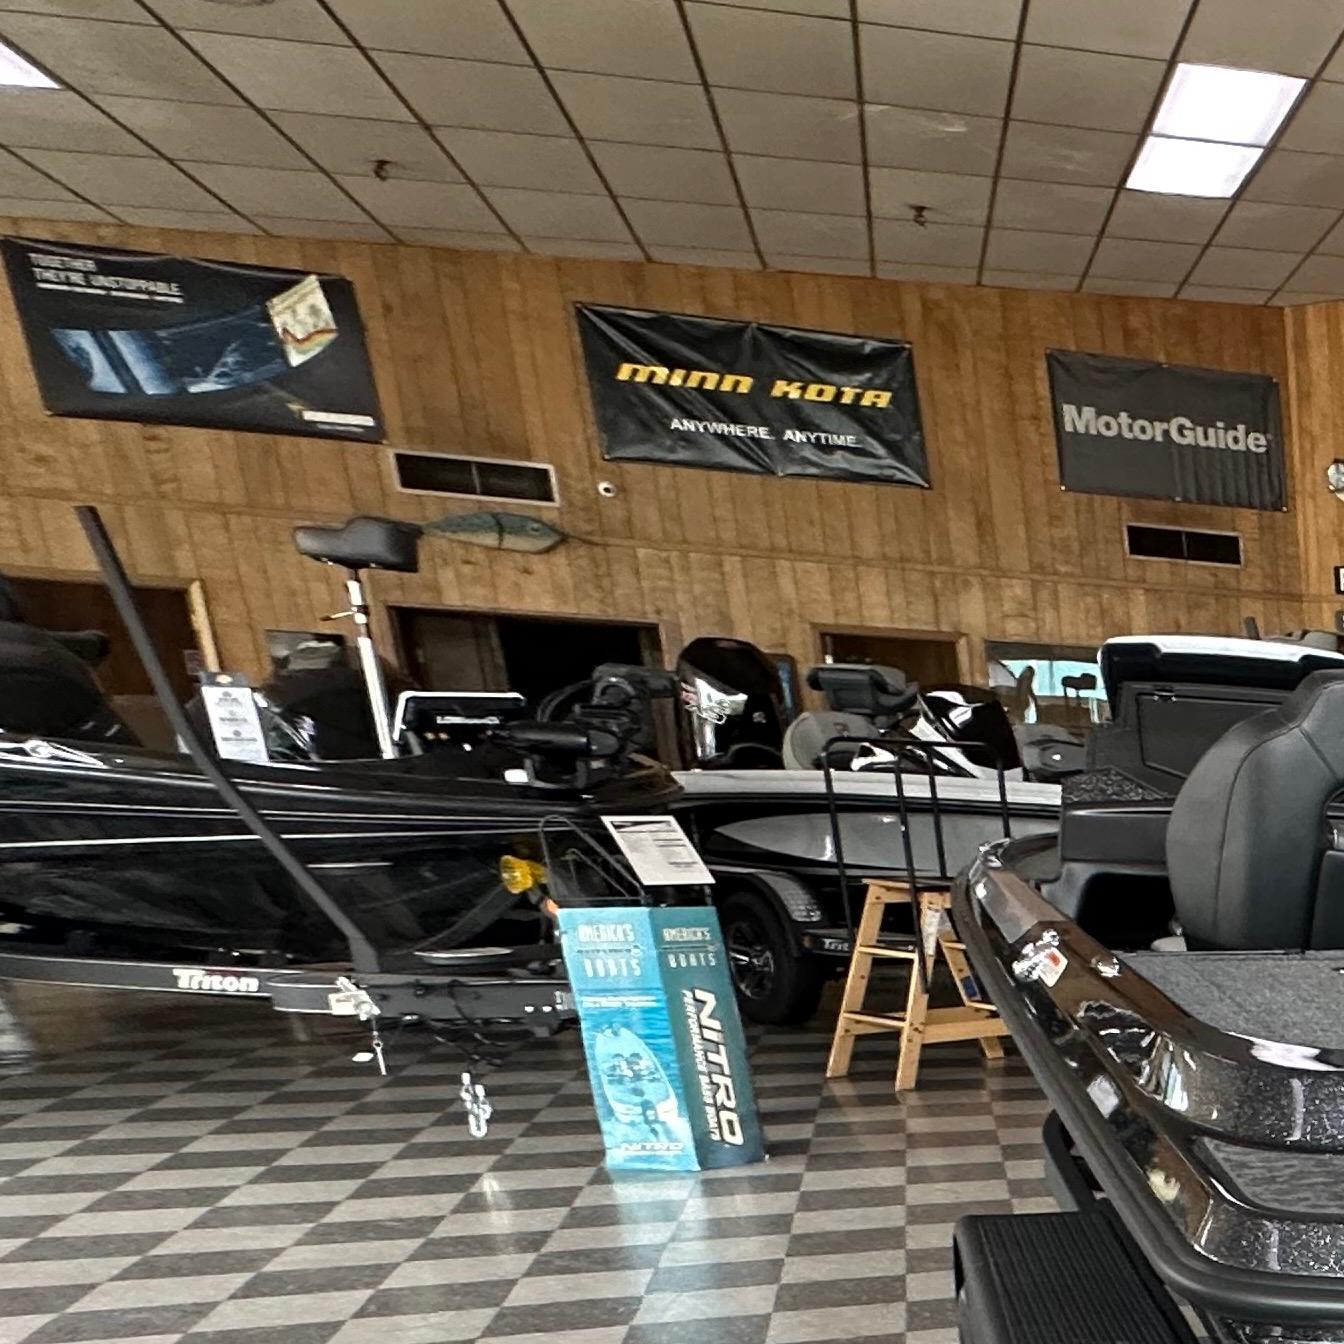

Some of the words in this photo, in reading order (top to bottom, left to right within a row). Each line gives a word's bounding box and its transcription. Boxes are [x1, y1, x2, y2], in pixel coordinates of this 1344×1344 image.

[770, 379, 893, 409] KOTA
[1062, 403, 1268, 453] MotorGuide
[172, 968, 259, 992] Triton
[694, 987, 745, 1147] NITRO
